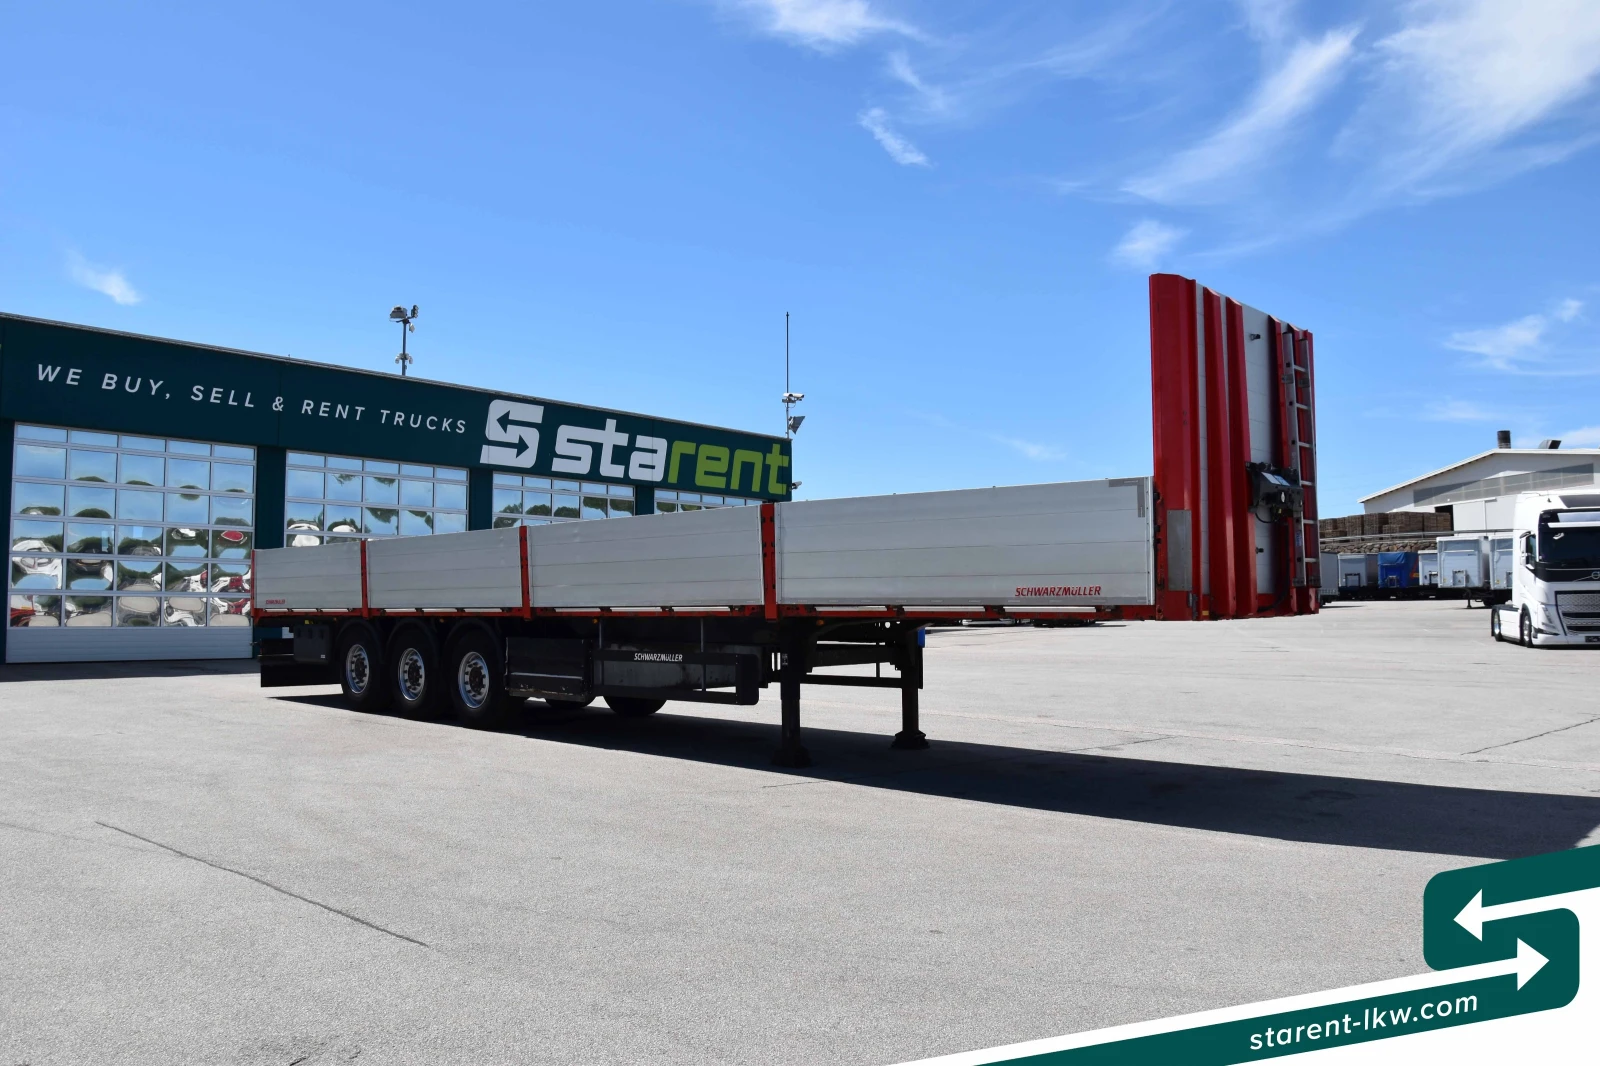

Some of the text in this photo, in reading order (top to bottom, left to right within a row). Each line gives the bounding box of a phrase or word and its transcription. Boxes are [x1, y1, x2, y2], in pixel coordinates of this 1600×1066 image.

[37, 363, 467, 434] WE BUY, SELL & RENT TRUCKS
[551, 418, 790, 495] starent
[1015, 586, 1102, 597] SCHWARZMÜLLER
[633, 652, 683, 662] SCHWARZMÜLLER
